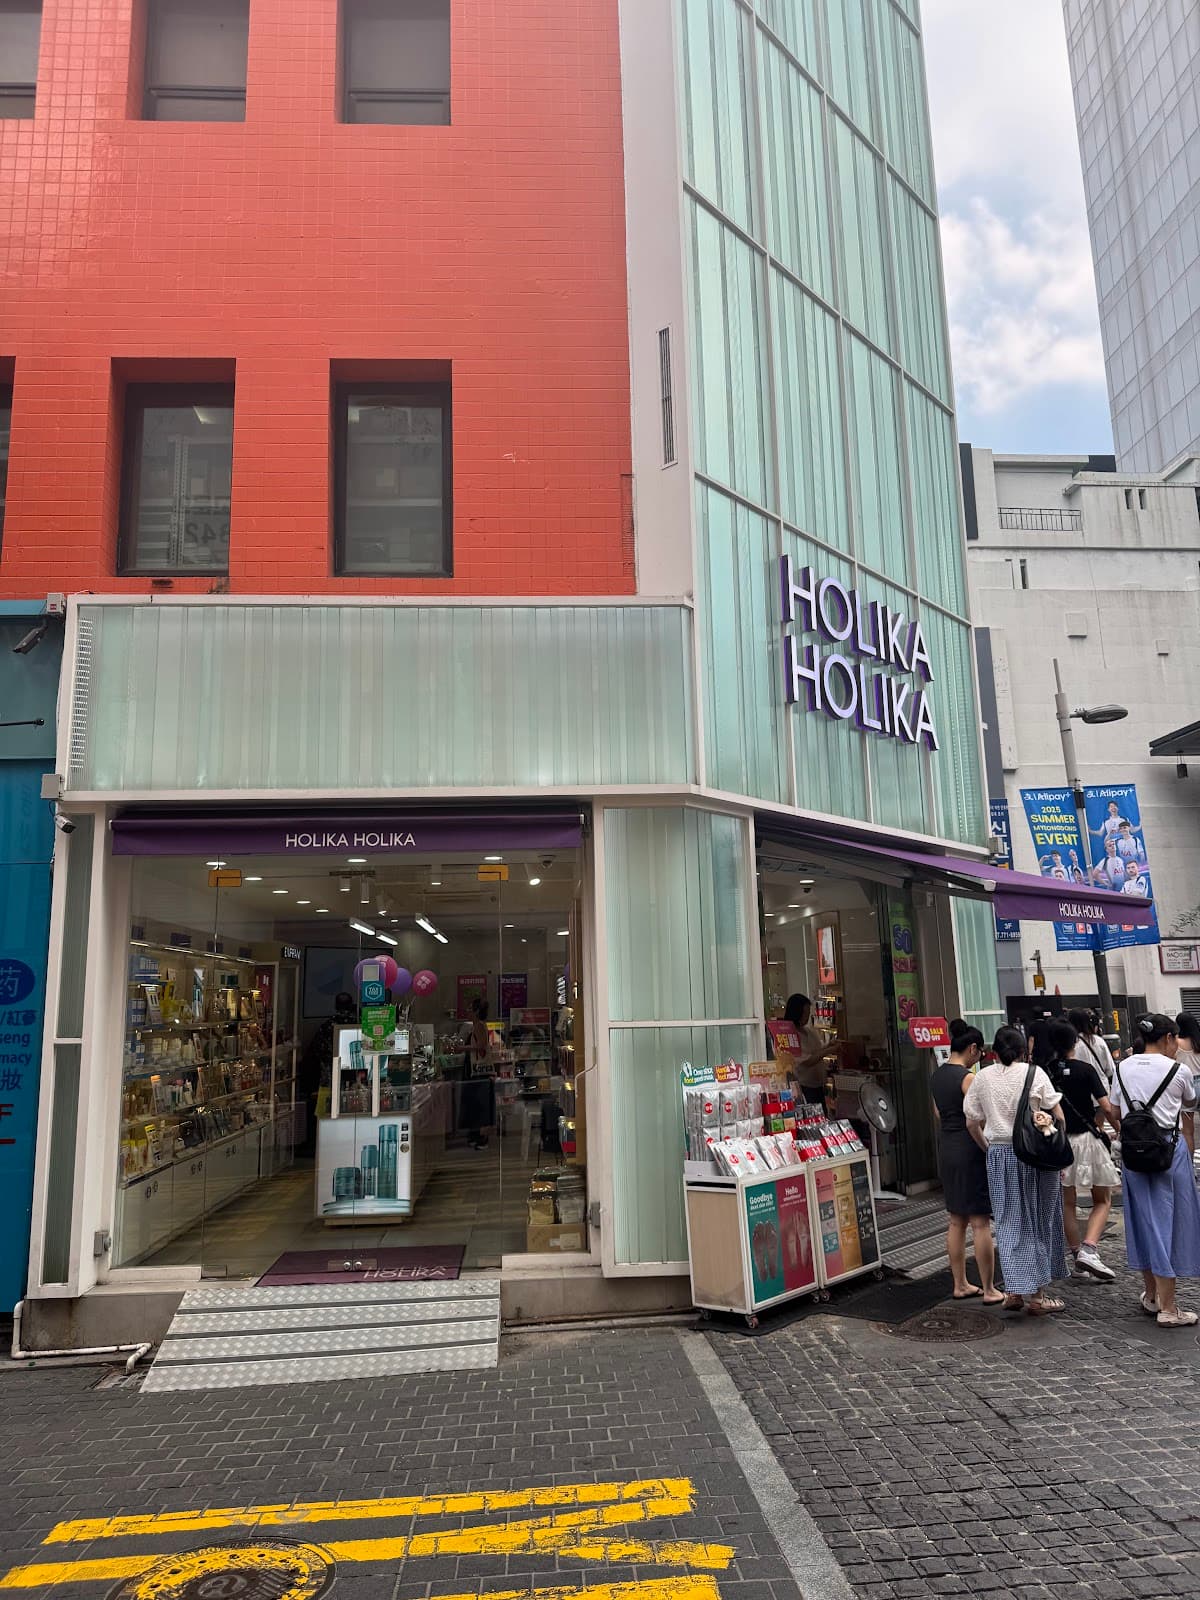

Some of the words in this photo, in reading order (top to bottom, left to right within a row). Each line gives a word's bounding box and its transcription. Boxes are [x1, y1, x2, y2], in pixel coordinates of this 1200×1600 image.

[780, 554, 934, 683] HOLIKA
[784, 634, 939, 752] HOLIKA
[1031, 814, 1075, 823] SUMMER
[285, 832, 348, 848] HOLIKA
[353, 832, 416, 848] HOLIKA
[1035, 833, 1078, 846] EVENT
[1058, 902, 1083, 917] HOLIKA
[1082, 904, 1105, 919] HOLIKA
[913, 1027, 931, 1043] 50
[749, 1193, 774, 1205] Goodbye
